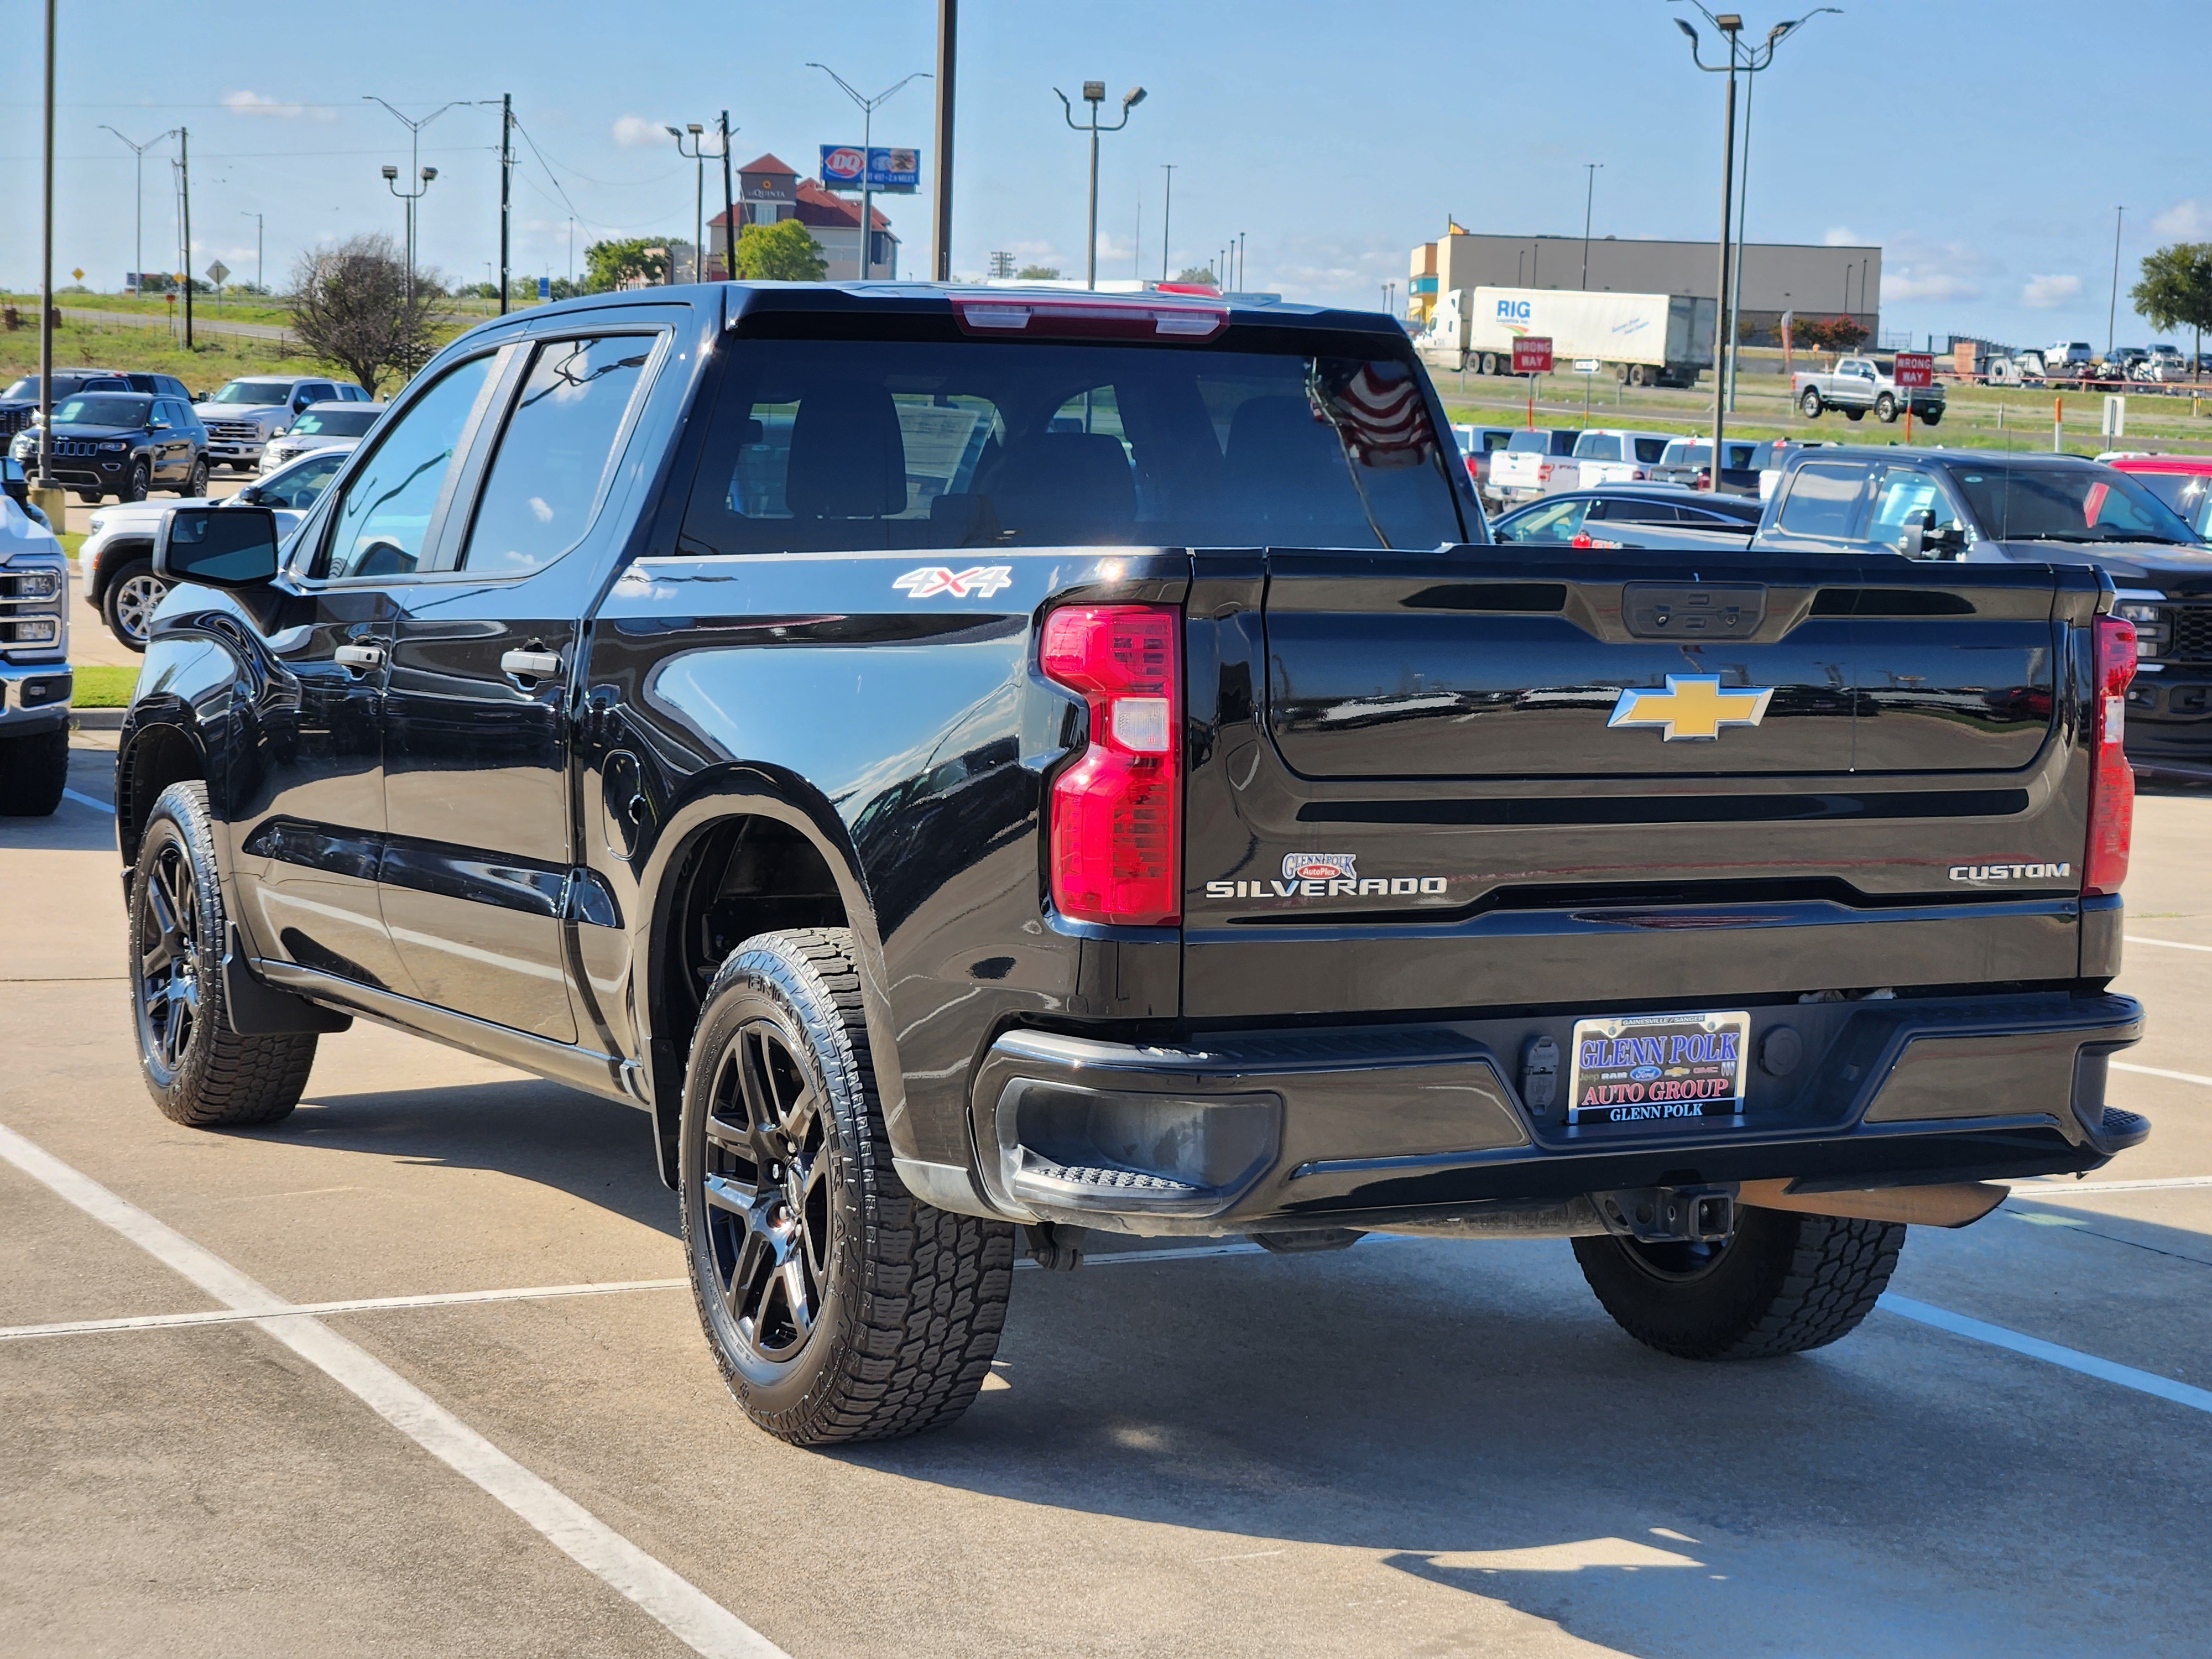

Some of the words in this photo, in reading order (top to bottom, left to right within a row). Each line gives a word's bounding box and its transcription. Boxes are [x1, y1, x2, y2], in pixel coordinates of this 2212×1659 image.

[833, 154, 859, 171] DQ
[860, 172, 873, 181] EIT
[899, 174, 915, 182] MILES
[754, 189, 785, 198] QUINTA
[1497, 300, 1531, 318] RIG
[1516, 341, 1551, 353] WRONG
[1521, 355, 1544, 367] WAY
[1897, 358, 1931, 369] WRONG
[1903, 372, 1924, 382] WAY
[1282, 853, 1323, 879] GLENN
[1326, 853, 1357, 879] POLK
[1302, 867, 1336, 877] AutoPlex
[1949, 863, 2070, 881] CUSTOM
[1206, 877, 1448, 898] SILVERADO
[1579, 1036, 1667, 1070] GLENN
[1669, 1032, 1740, 1064] POLK
[1579, 1073, 1600, 1082] Jeep
[1600, 1072, 1628, 1080] RAM
[1582, 1081, 1645, 1106] AUTO
[1648, 1078, 1729, 1101] GROUP
[1610, 1105, 1664, 1121] GLENN
[1663, 1103, 1703, 1118] POLK
